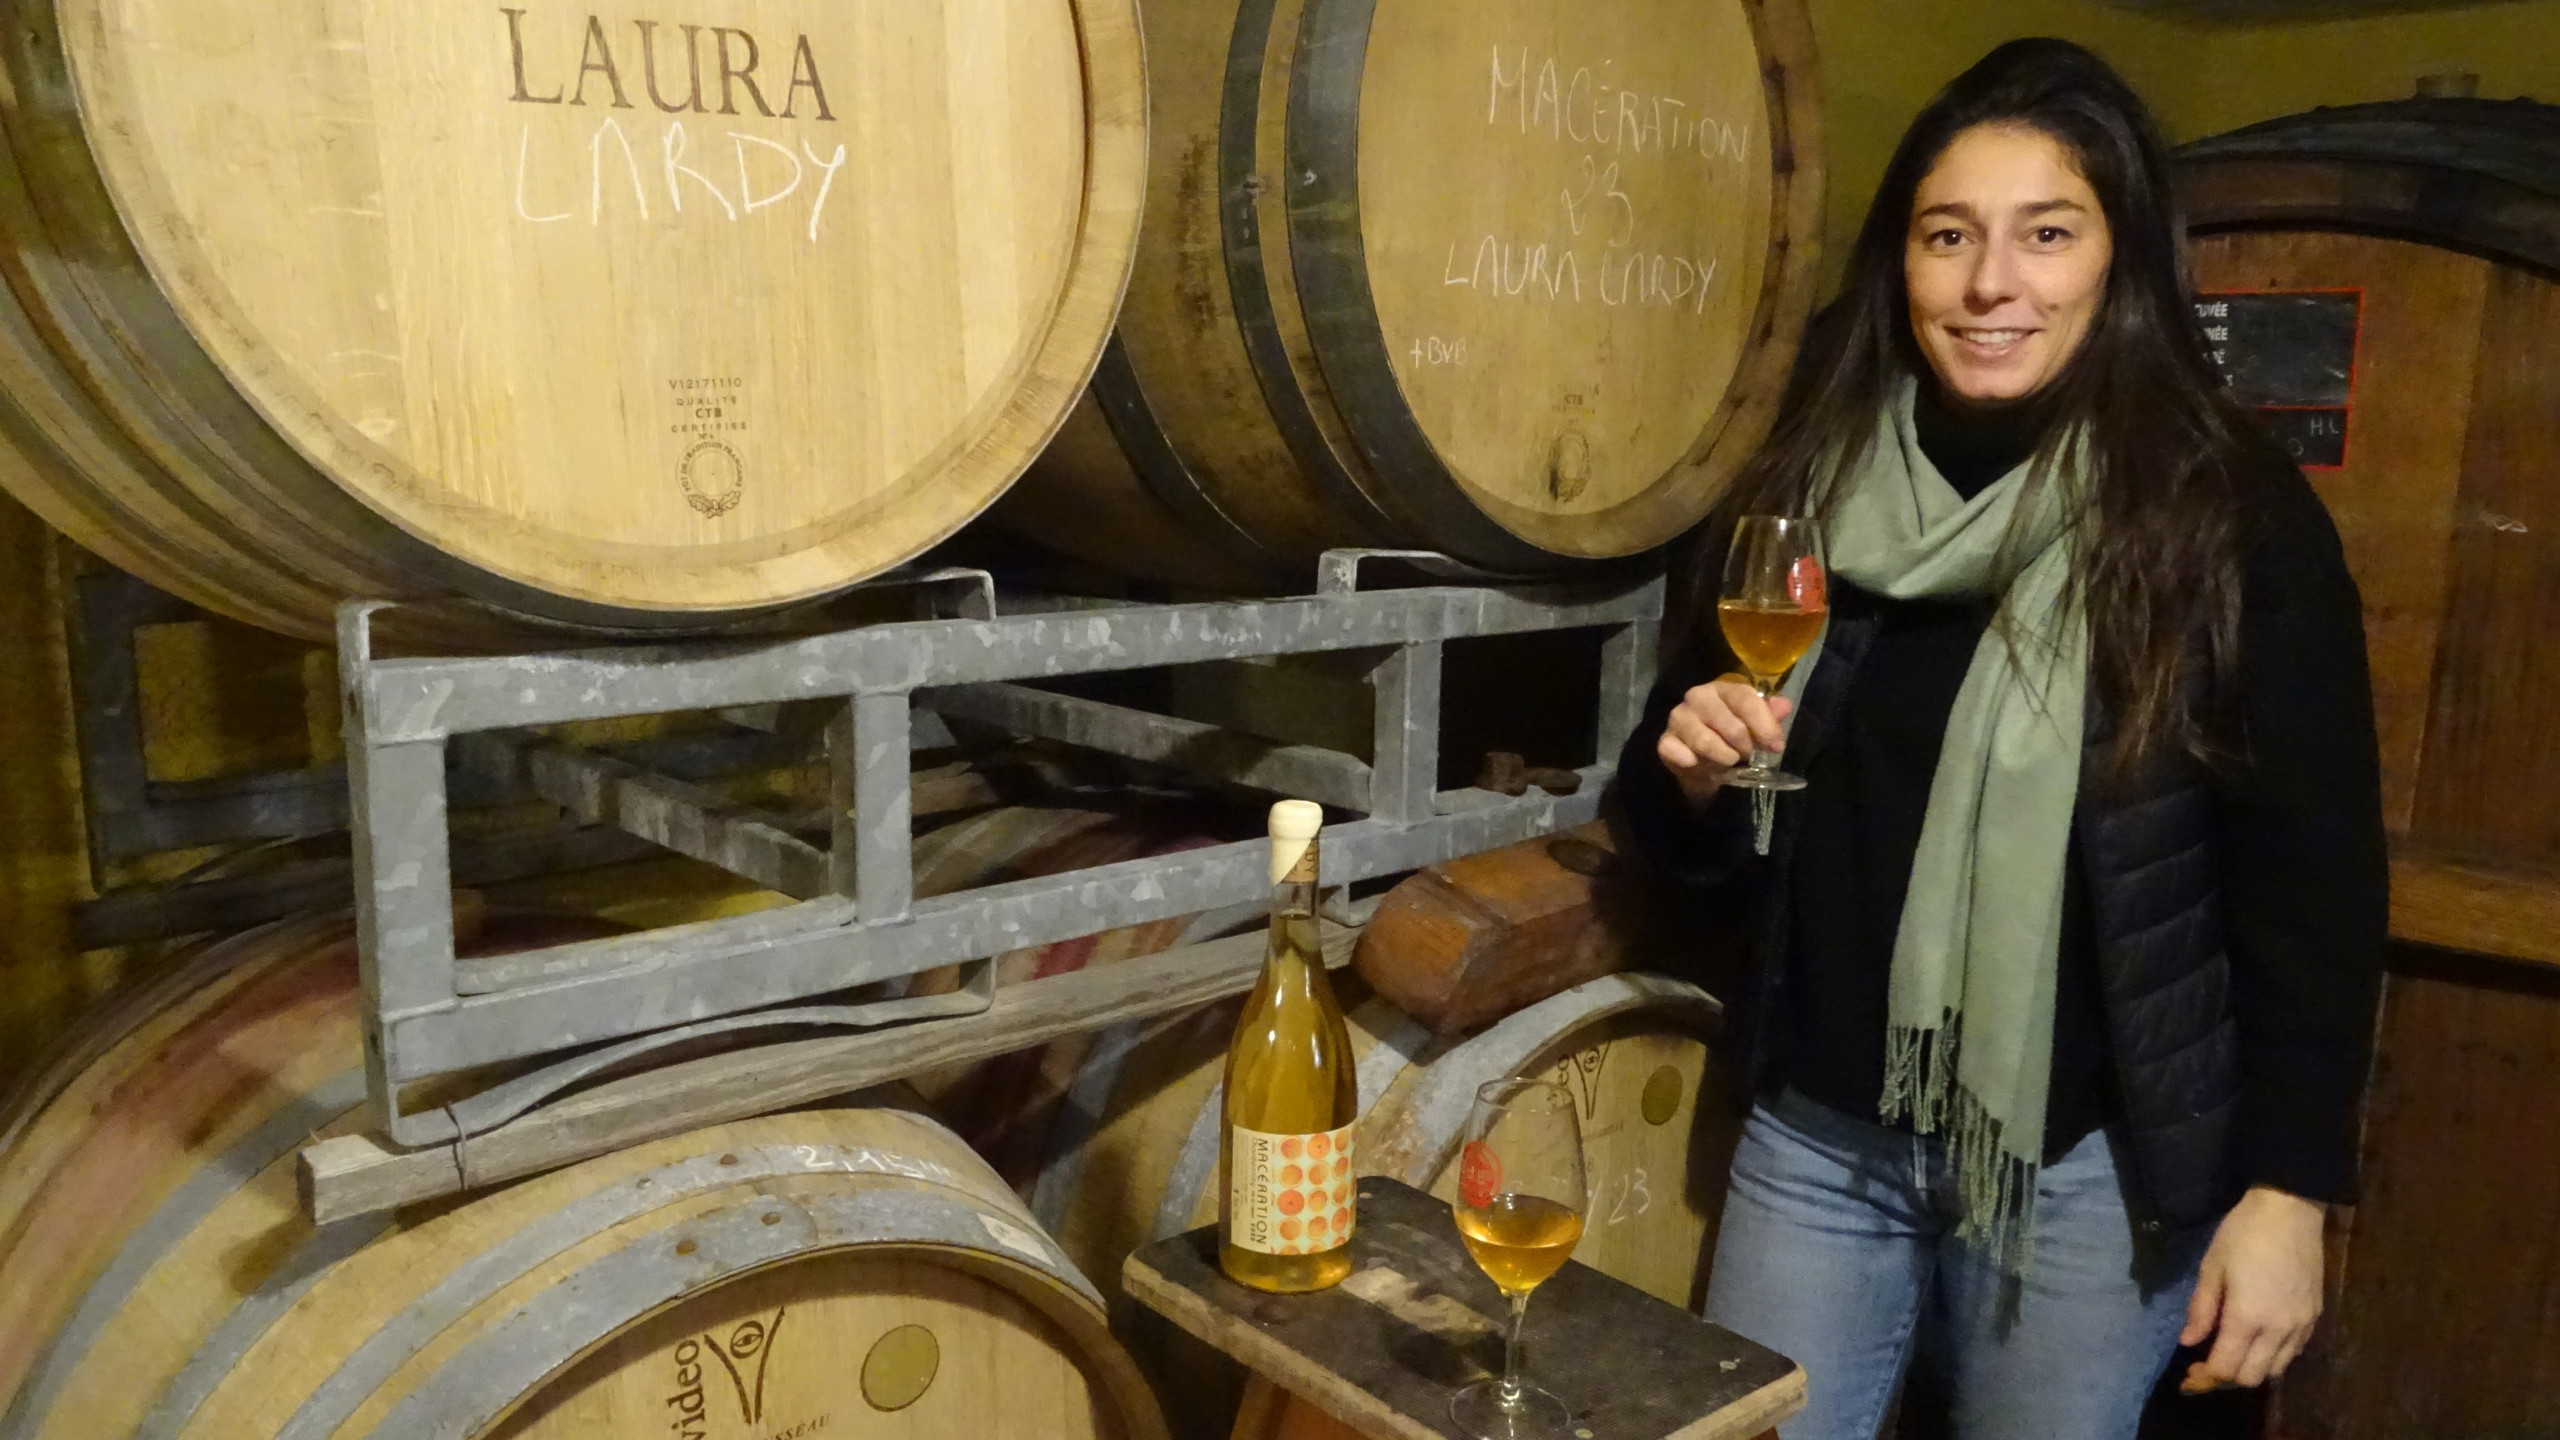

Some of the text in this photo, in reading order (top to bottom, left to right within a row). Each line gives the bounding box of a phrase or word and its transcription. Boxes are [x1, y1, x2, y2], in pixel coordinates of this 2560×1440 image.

[500, 8, 837, 120] LAURA
[1488, 44, 1748, 162] MACÉRATION
[516, 116, 846, 242] LARDY
[1560, 154, 1634, 248] 23
[1445, 235, 1716, 315] LAURA LARDY
[669, 377, 742, 390] V12171110
[695, 408, 722, 419] CTB
[1256, 1138, 1269, 1245] MACÉRATION
